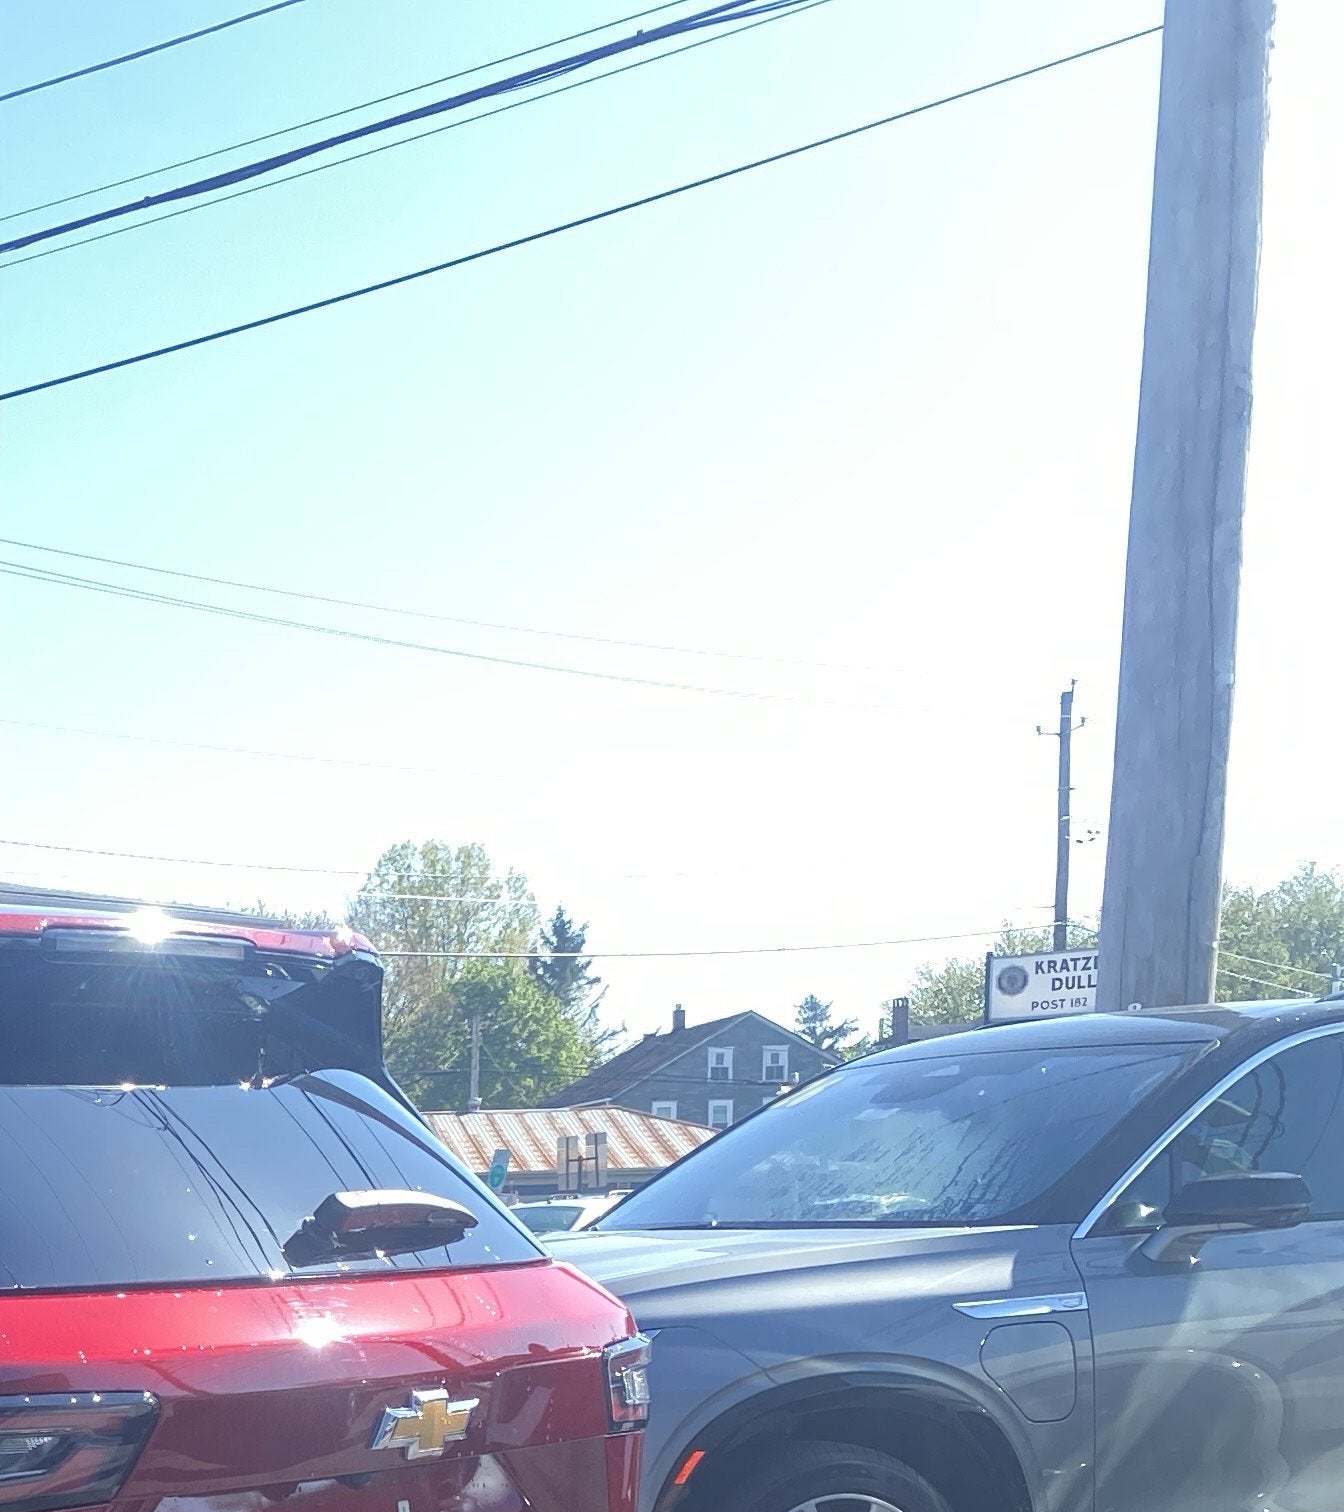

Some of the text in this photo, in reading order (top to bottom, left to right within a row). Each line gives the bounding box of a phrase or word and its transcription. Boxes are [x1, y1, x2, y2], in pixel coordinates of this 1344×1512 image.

[1051, 974, 1098, 992] DULL
[1031, 997, 1088, 1011] POST 182
